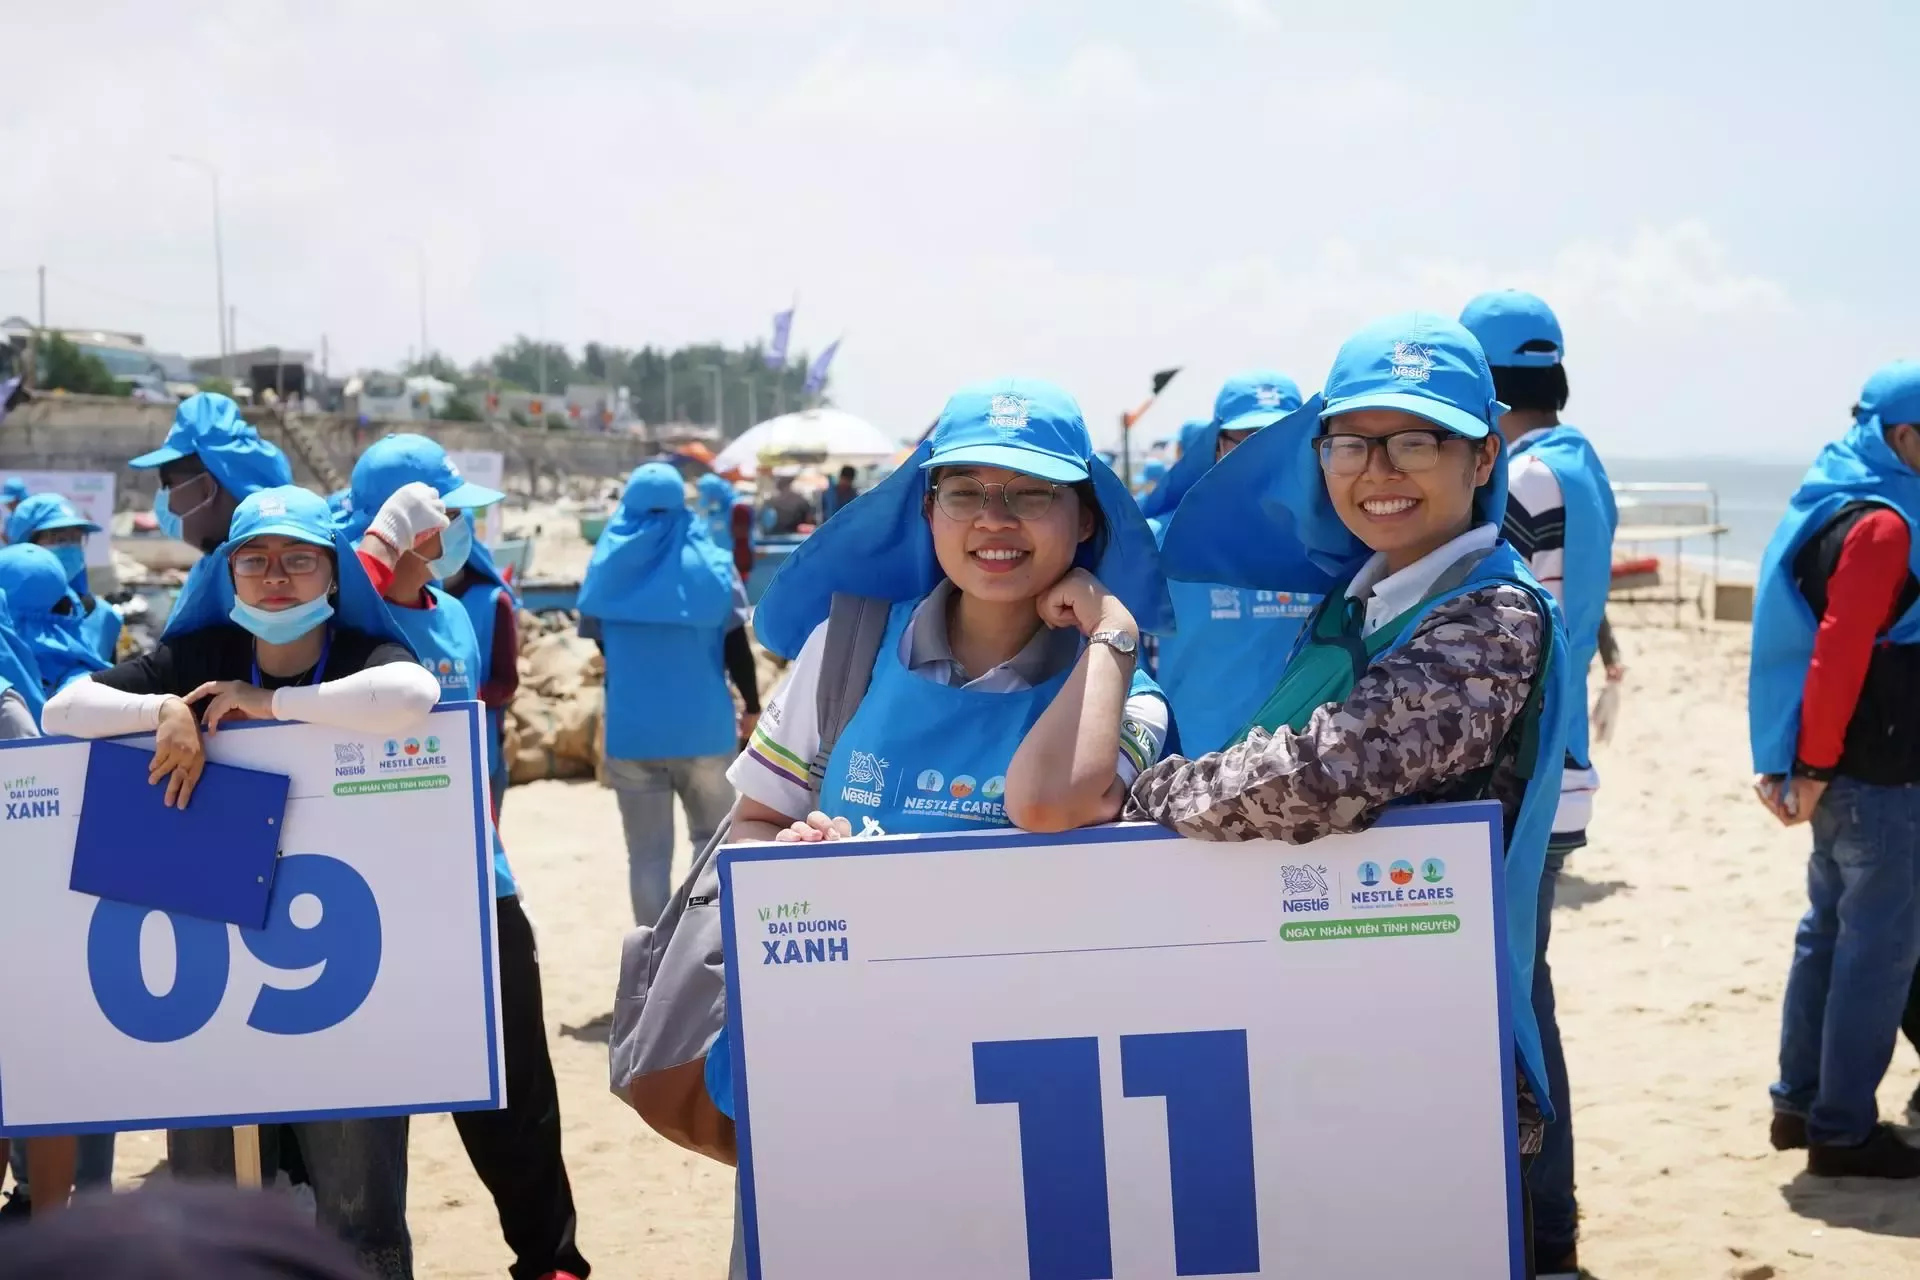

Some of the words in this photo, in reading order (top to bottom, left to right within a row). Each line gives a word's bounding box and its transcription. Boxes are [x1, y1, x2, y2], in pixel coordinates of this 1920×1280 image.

[416, 755, 447, 766] CARES
[841, 785, 882, 807] Nestlé
[904, 795, 959, 811] NESTLÉ
[5, 800, 60, 820] XANH
[1351, 887, 1404, 904] NESTLÉ
[1408, 886, 1454, 900] CARES
[768, 922, 793, 937] ĐẠI
[797, 919, 848, 933] DƯƠNG
[87, 852, 382, 1043] 09
[761, 937, 849, 965] XANH
[972, 1028, 1260, 1280] 11
